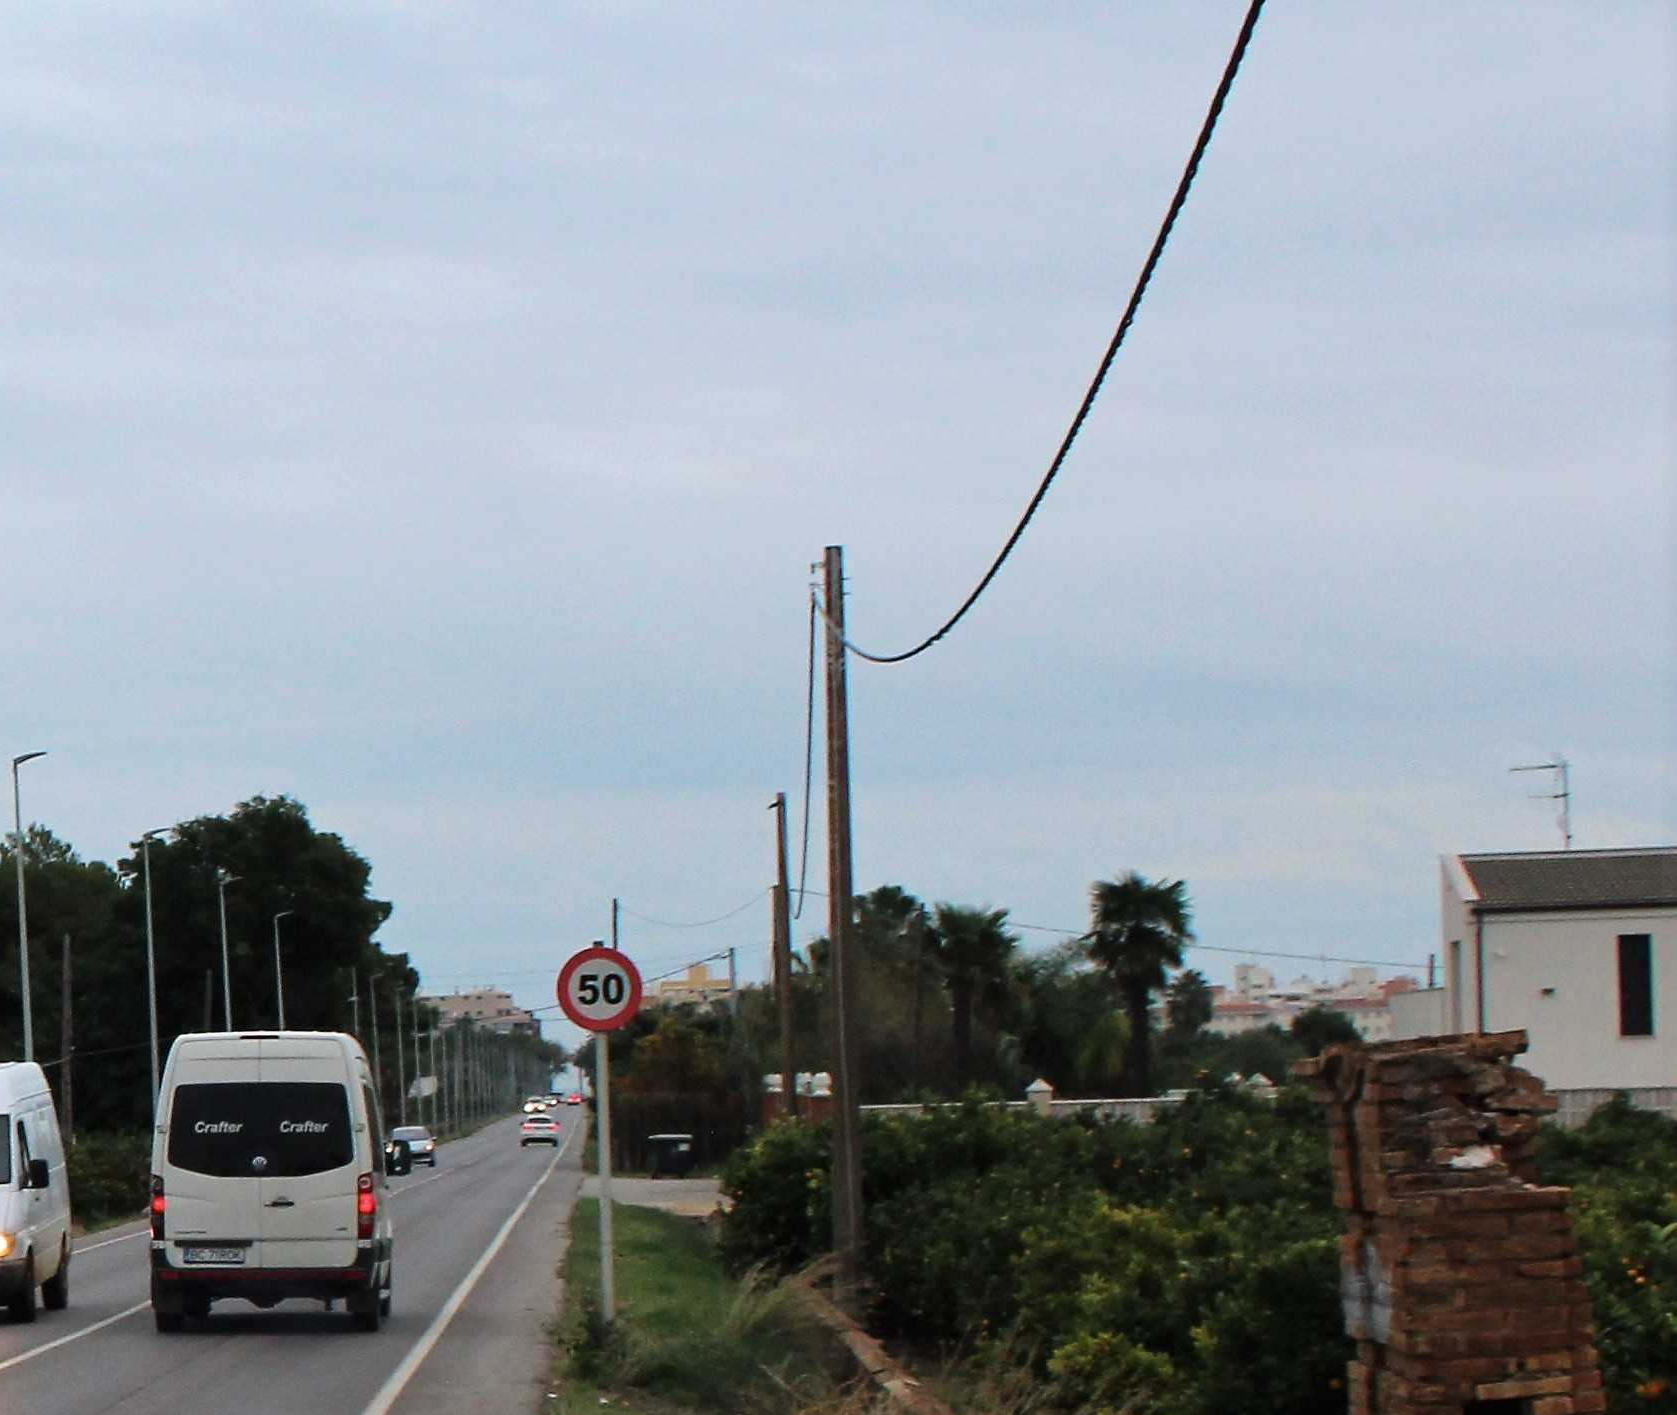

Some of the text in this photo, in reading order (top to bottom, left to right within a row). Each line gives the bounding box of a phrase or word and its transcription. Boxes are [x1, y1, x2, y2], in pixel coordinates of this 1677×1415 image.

[578, 973, 623, 1005] 50
[195, 1120, 243, 1133] Crafter
[279, 1120, 328, 1133] Crafter
